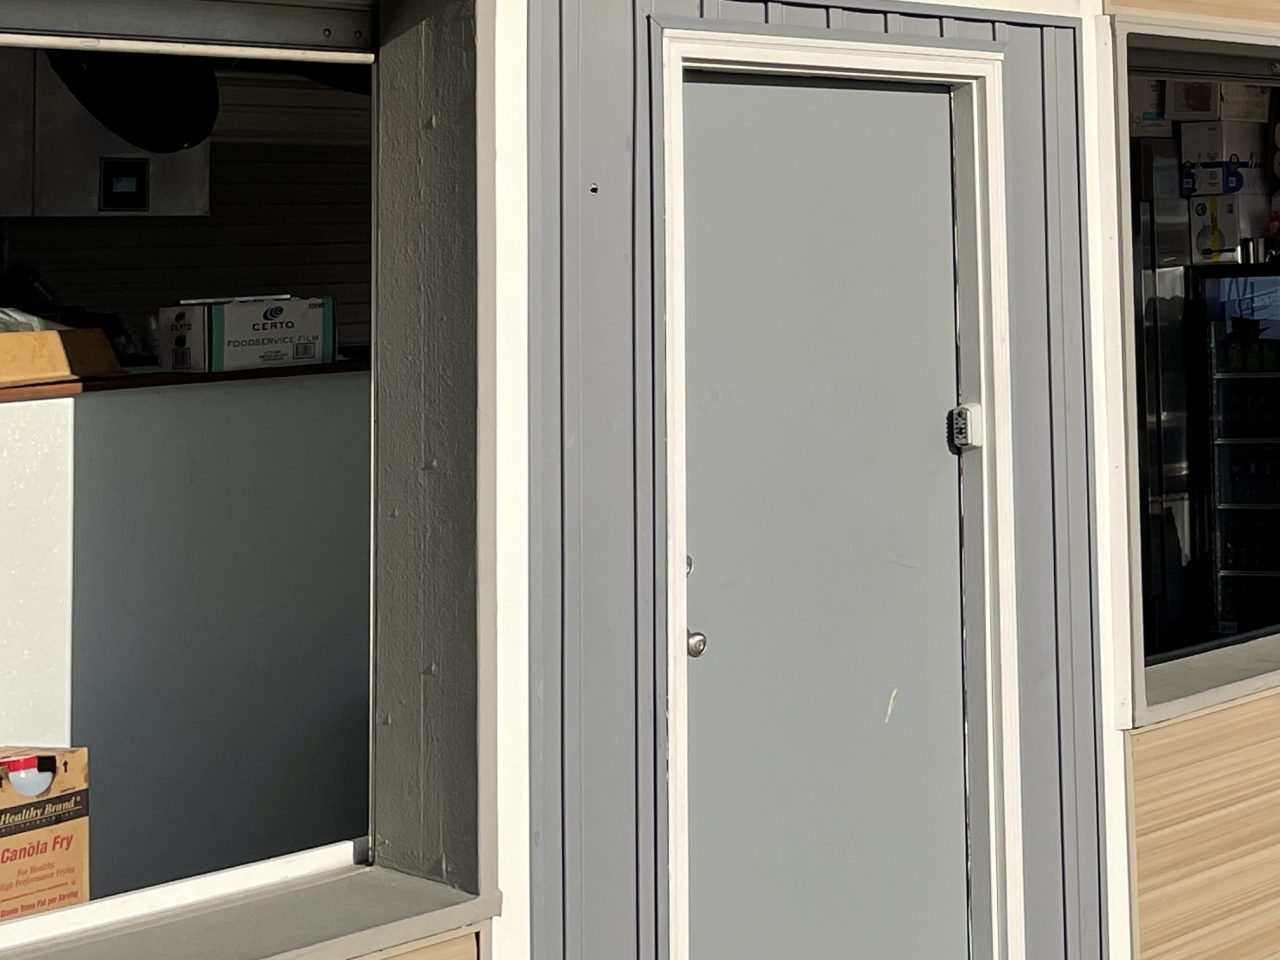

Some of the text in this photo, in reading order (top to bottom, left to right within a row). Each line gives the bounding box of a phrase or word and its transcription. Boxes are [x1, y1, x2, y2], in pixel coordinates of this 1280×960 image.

[252, 321, 294, 332] CERTO
[226, 335, 320, 348] FOODSERVICE FILM
[0, 807, 43, 826] Healthy
[44, 797, 76, 815] Brand
[0, 835, 74, 864] Canola Fry
